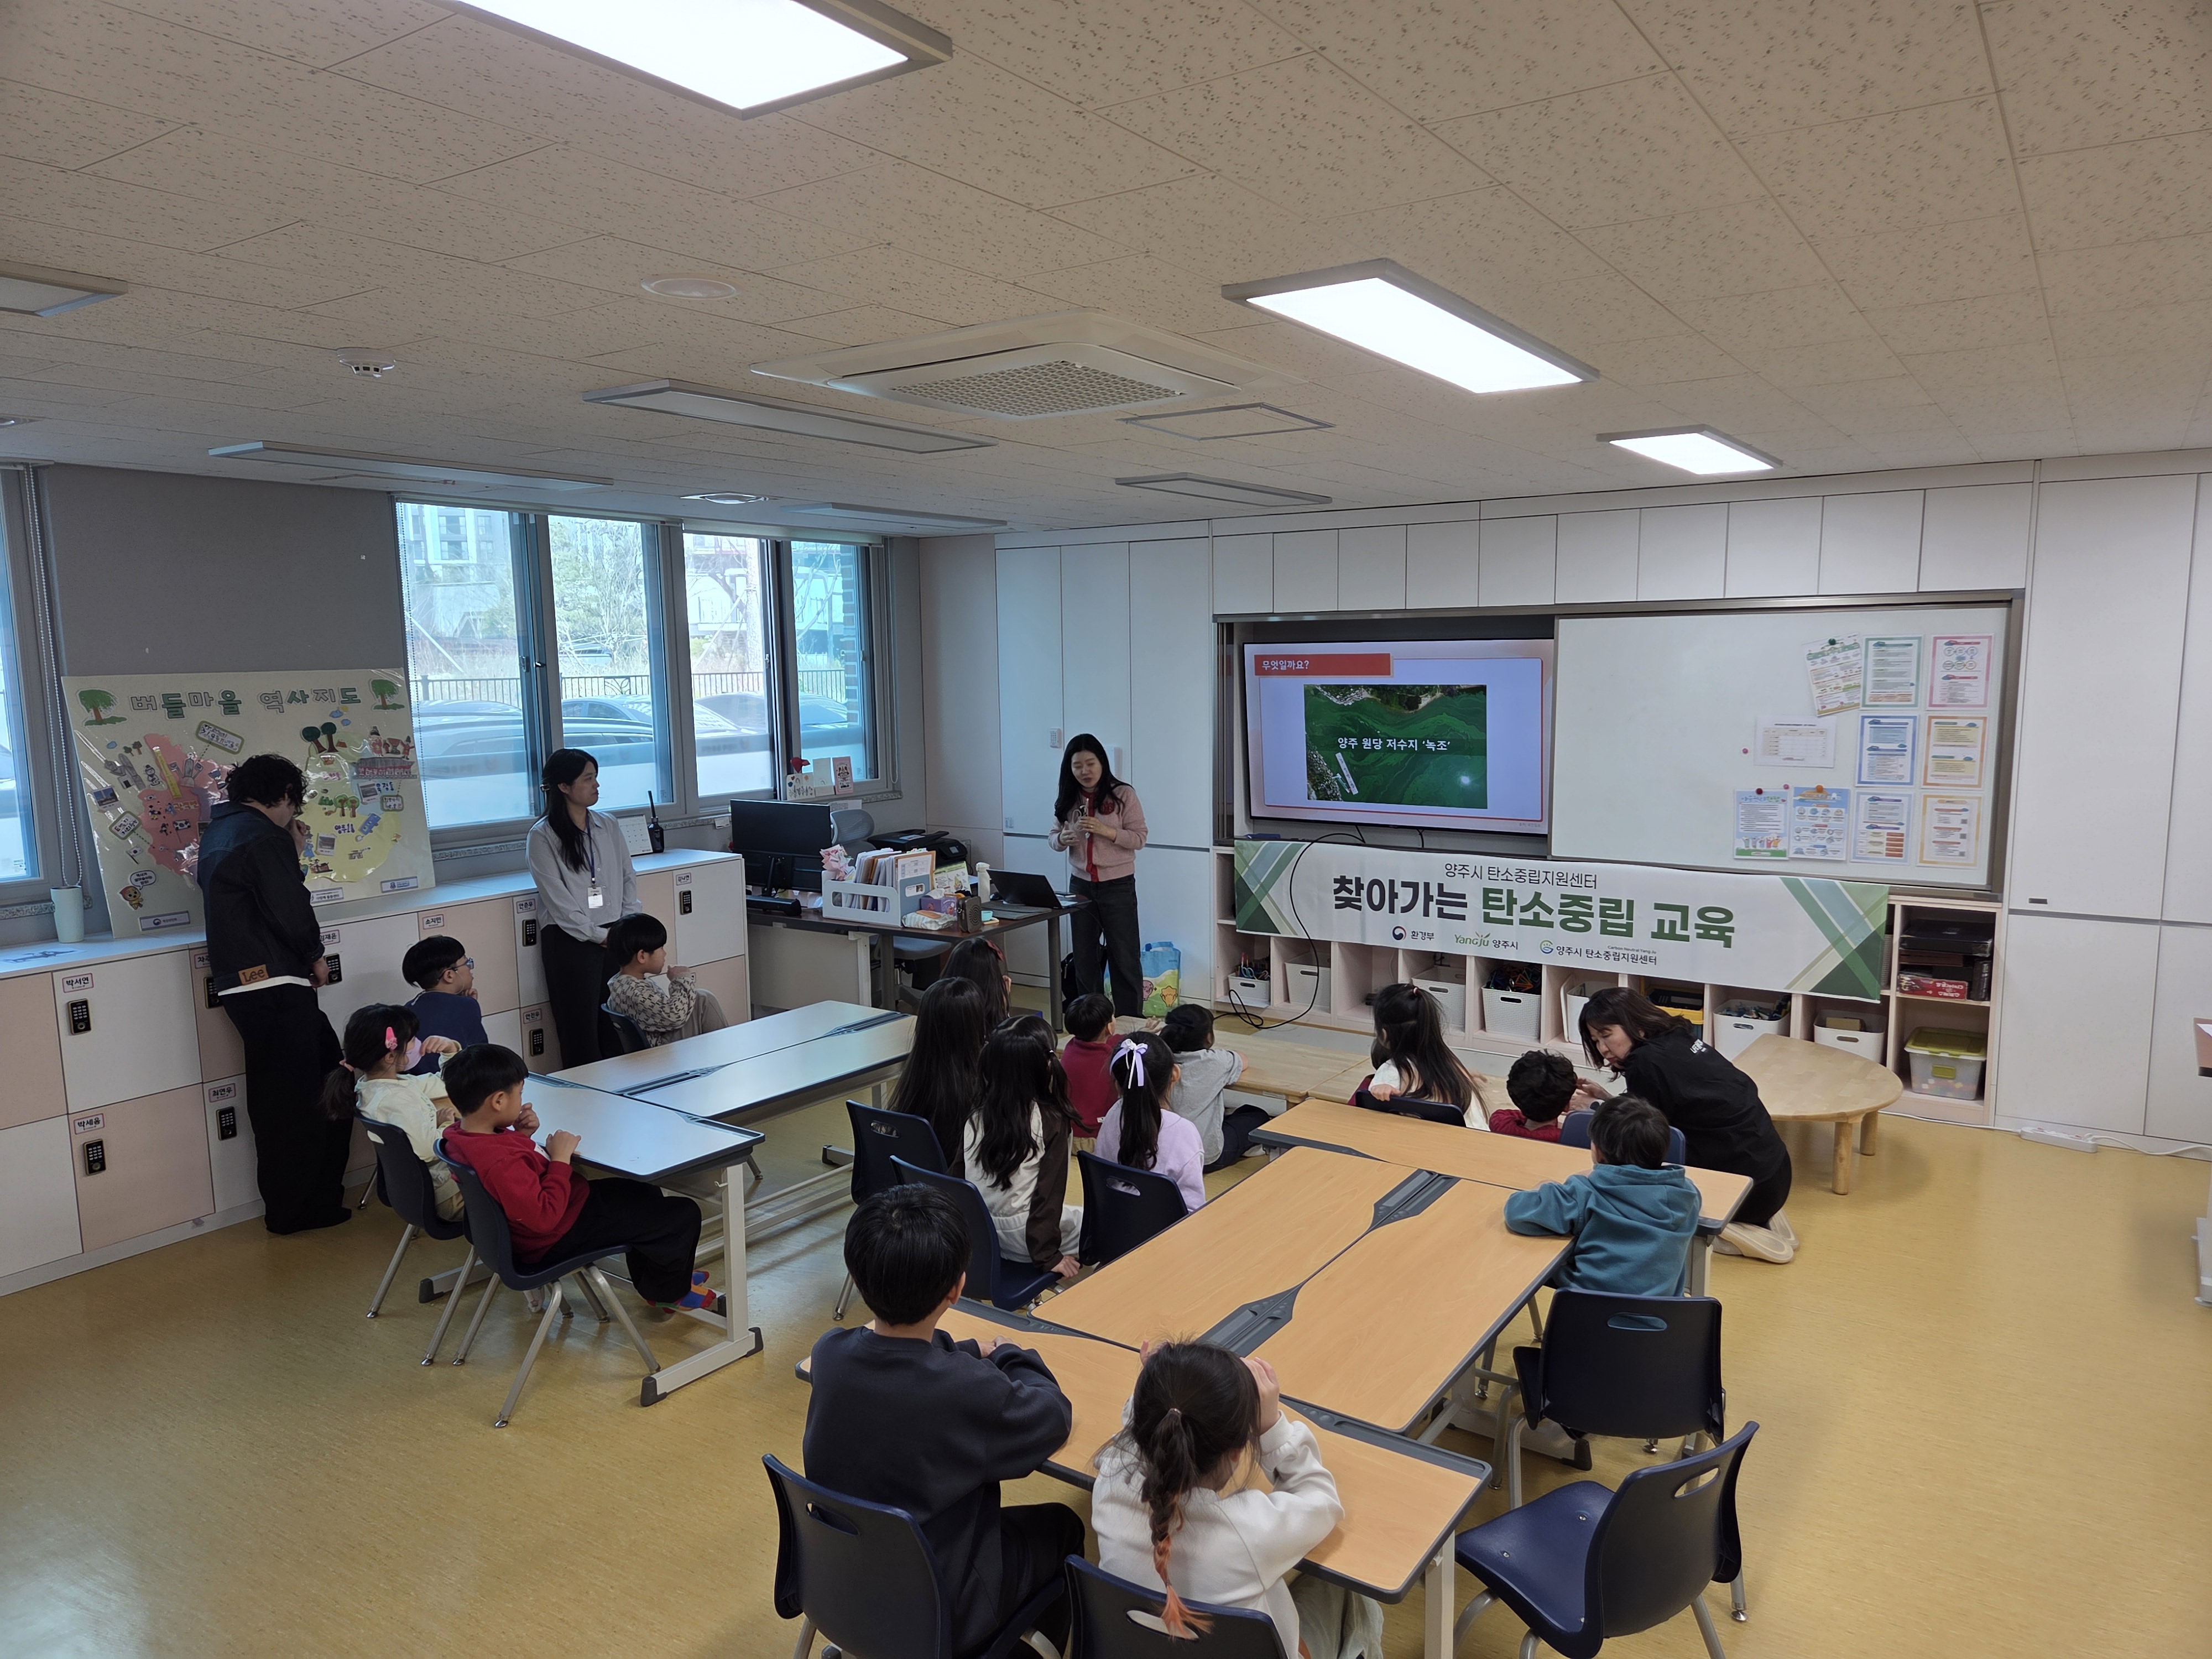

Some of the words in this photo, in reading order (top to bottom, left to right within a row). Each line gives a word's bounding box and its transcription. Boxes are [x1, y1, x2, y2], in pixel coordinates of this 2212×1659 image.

[1262, 660, 1309, 670] 무엇일까요?
[131, 690, 242, 719] 버들마을
[259, 687, 361, 713] 역사지도
[1338, 737, 1358, 749] 양주
[1362, 738, 1383, 750] 원당
[1386, 738, 1417, 751] 저수지
[1444, 863, 1483, 879] 양주시
[1488, 866, 1597, 889] 탄소중립지원센터
[1332, 875, 1468, 921] 찾아가는
[1482, 888, 1634, 938] 탄소중립
[1651, 902, 1735, 948] 교육
[1411, 930, 1434, 941] 환경부
[1493, 939, 1519, 950] 양주시
[1557, 945, 1582, 957] 양주시
[1585, 949, 1657, 965] 탄소중립지원센터
[66, 977, 90, 987] 박서연
[242, 968, 266, 982] Lee
[212, 1087, 233, 1097] 최연우
